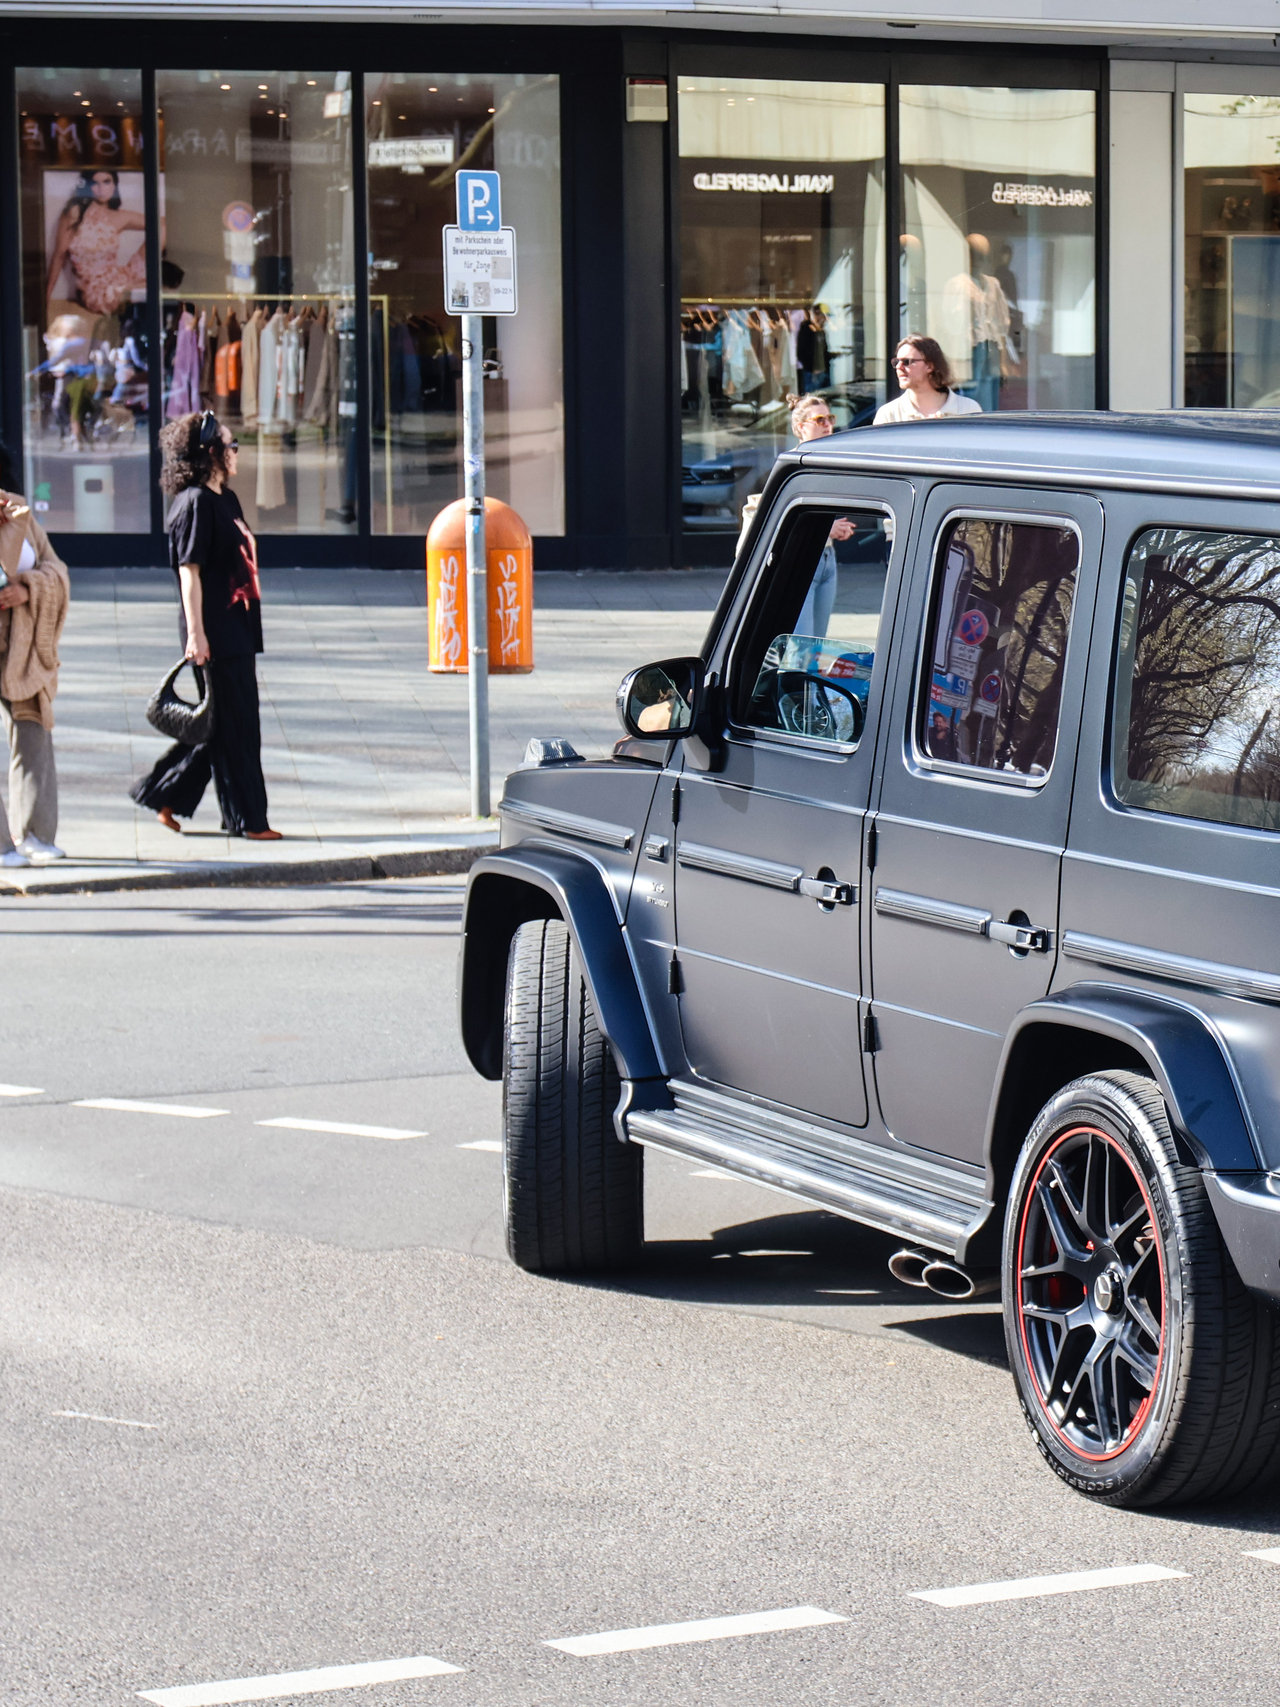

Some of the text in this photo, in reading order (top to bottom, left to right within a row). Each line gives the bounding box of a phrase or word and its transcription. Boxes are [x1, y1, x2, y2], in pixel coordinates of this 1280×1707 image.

[467, 179, 490, 225] P
[455, 235, 504, 245] mit Parkschein oder
[464, 260, 473, 269] für
[476, 260, 490, 269] Zone
